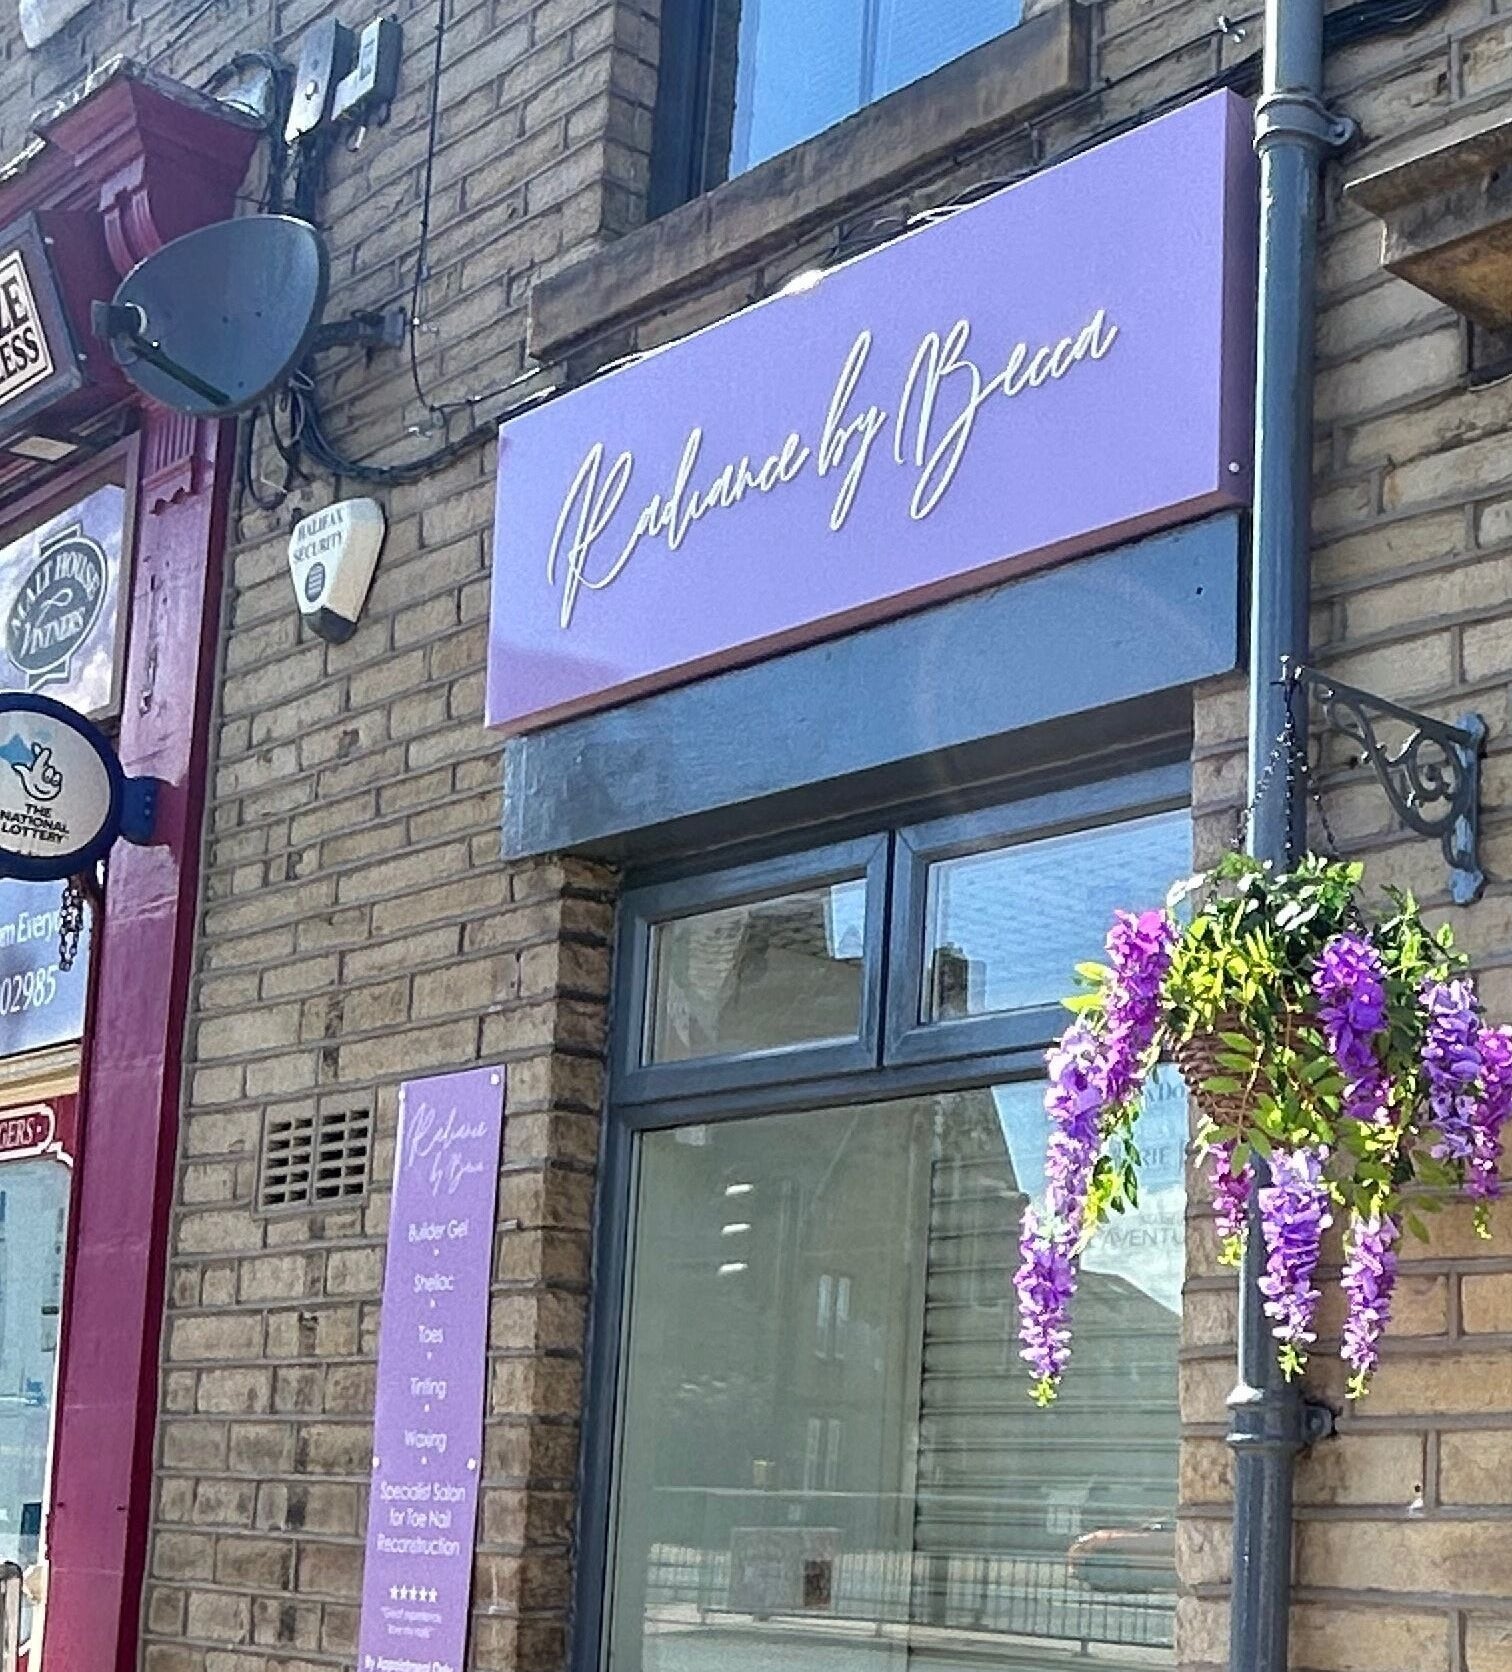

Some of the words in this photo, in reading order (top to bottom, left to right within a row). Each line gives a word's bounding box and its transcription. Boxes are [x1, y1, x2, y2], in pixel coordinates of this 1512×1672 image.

[0, 327, 39, 381] ESS
[546, 427, 811, 630] Radiance
[818, 329, 888, 532] by
[894, 309, 1119, 520] Becca
[293, 530, 343, 562] SECURITY
[0, 809, 70, 834] NATIONAL
[25, 803, 52, 818] THE
[1, 821, 66, 844] LOTTERY
[0, 965, 60, 1016] 02985
[408, 1222, 446, 1243] Builder
[447, 1219, 469, 1239] Gel
[413, 1272, 455, 1293] Shellac
[418, 1324, 444, 1344] Toes
[410, 1377, 448, 1399] Tinting
[404, 1429, 448, 1453] Waxing
[380, 1481, 432, 1503] Specialist
[433, 1482, 466, 1503] Salon
[406, 1507, 427, 1528] Toe
[428, 1509, 451, 1529] Nail
[376, 1534, 460, 1556] Reconstruction
